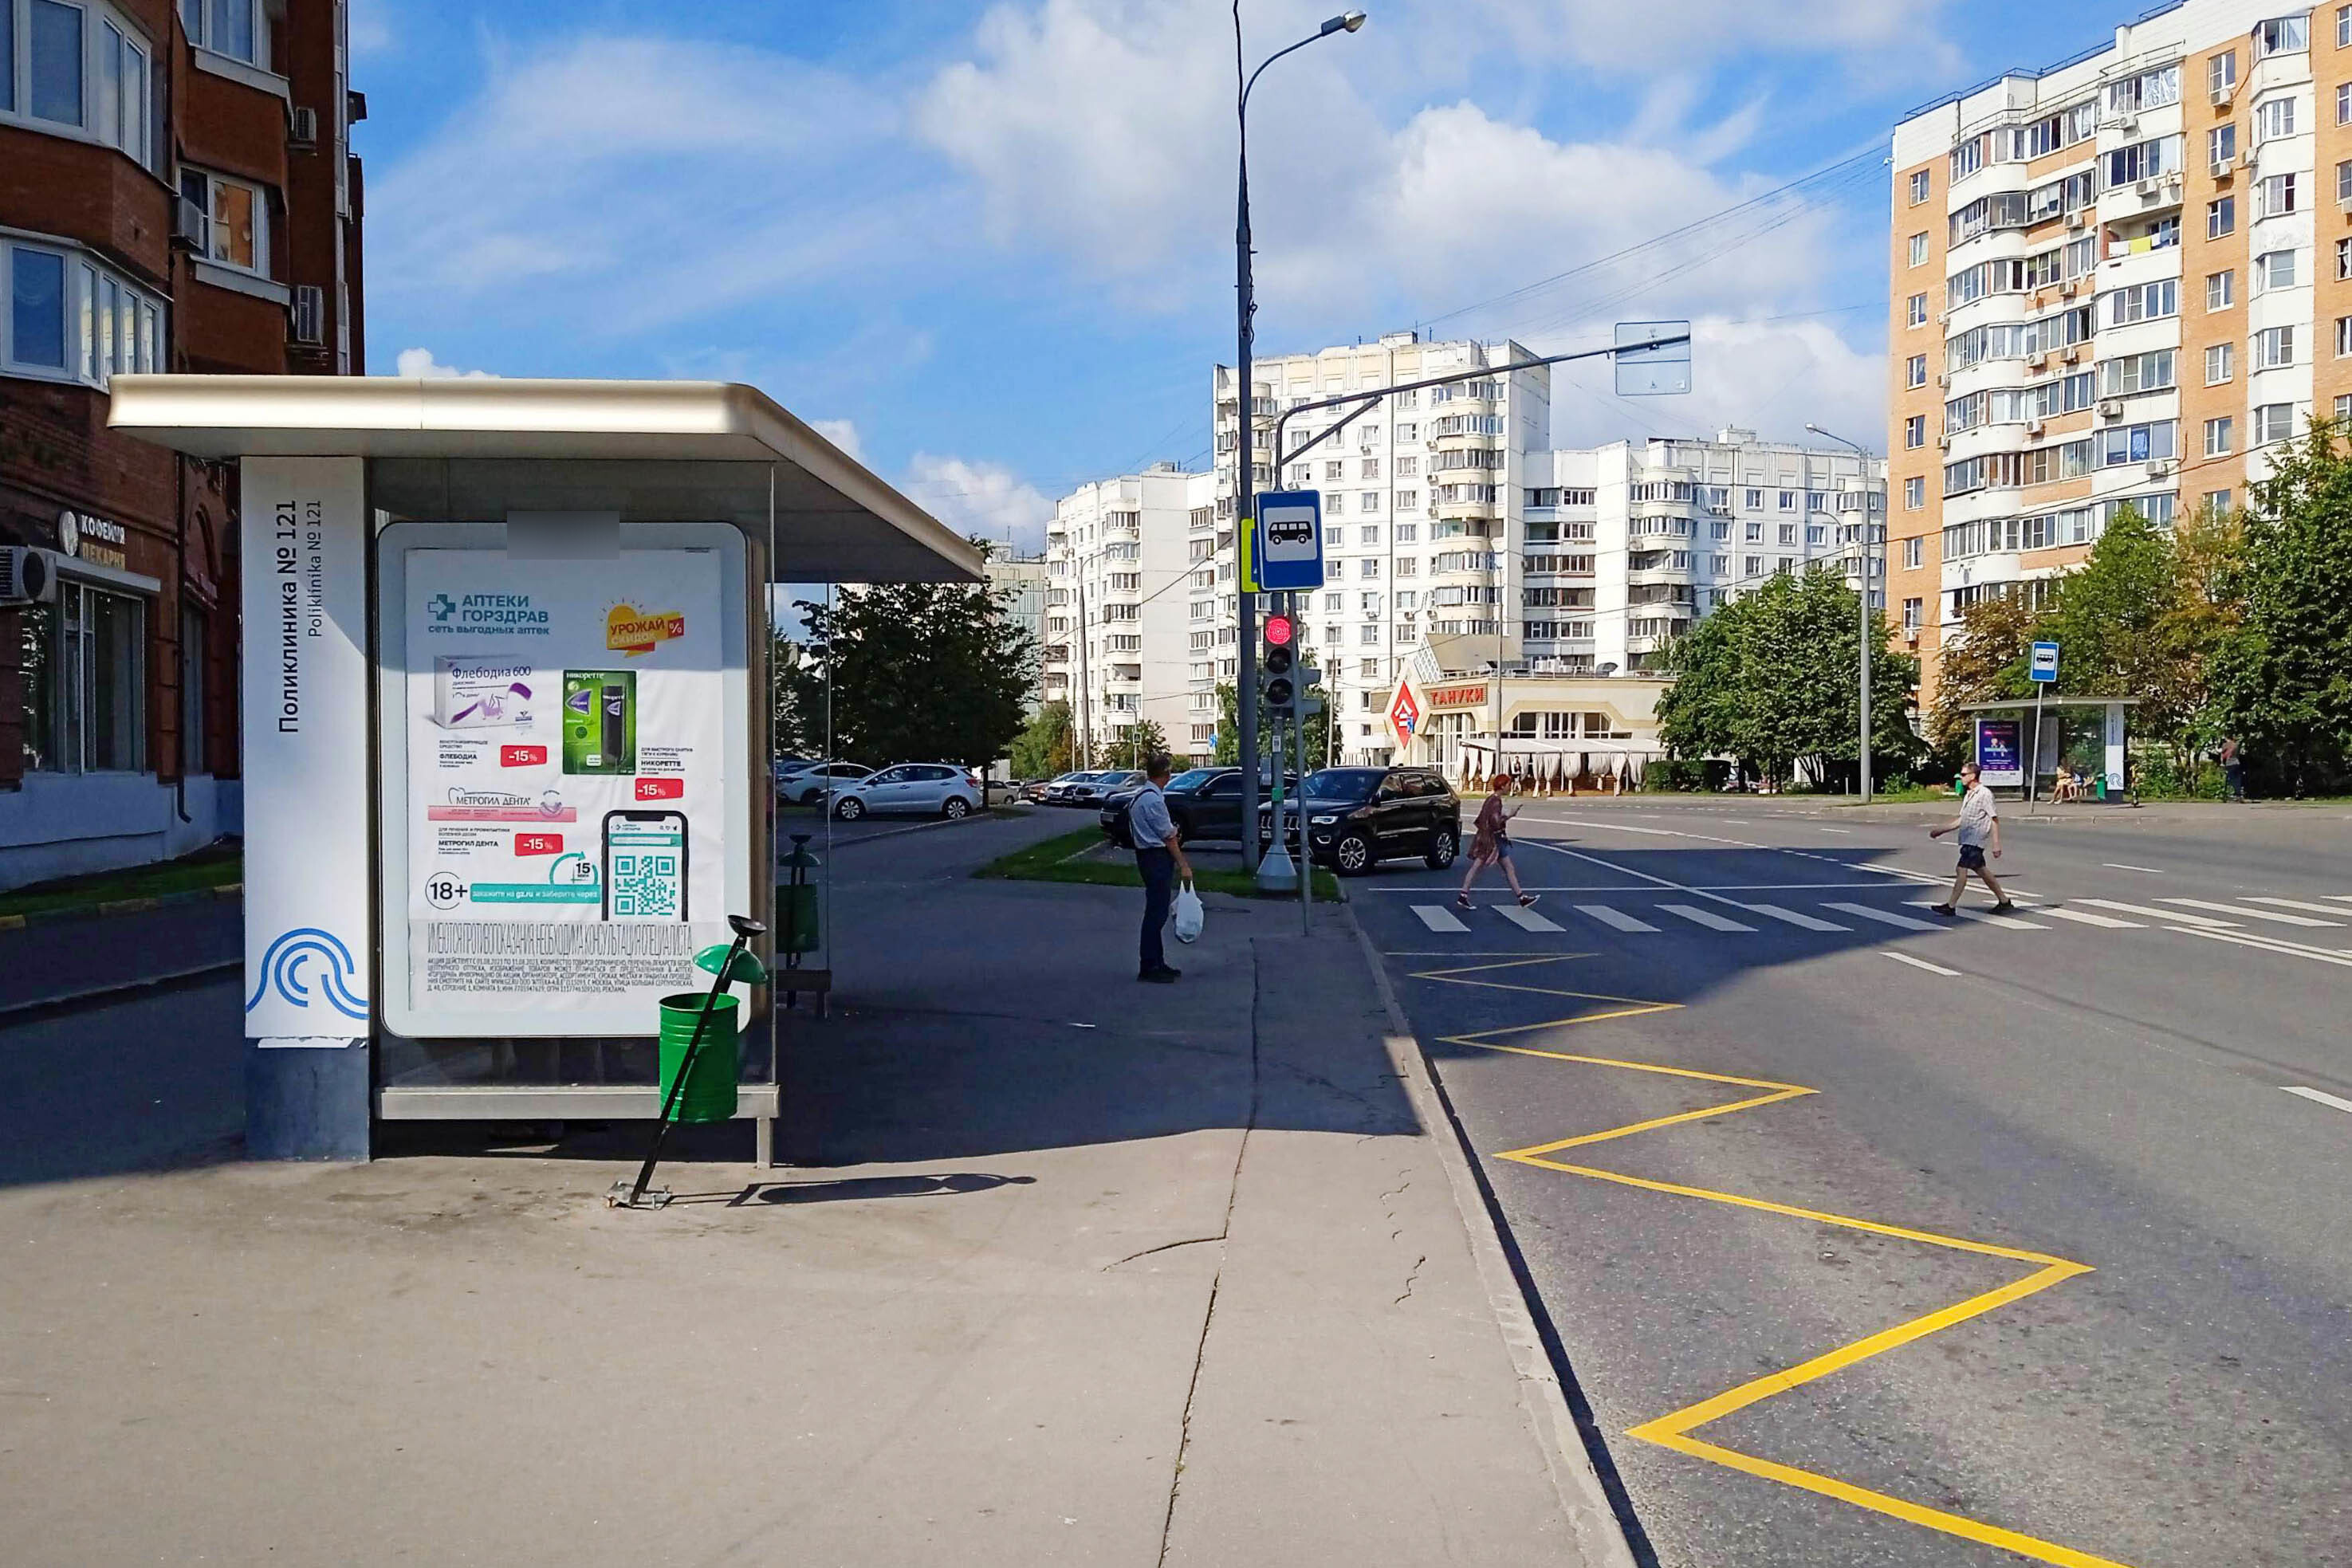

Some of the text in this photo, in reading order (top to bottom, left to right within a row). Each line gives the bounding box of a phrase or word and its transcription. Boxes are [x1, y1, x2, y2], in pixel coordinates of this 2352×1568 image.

[81, 514, 125, 544] КОФЕЙНЯ
[306, 501, 322, 637] Poliklinika № 121
[462, 595, 529, 607] АПТЕКИ
[276, 500, 299, 733] Поликлиника № 121
[462, 610, 549, 624] ГОРЗДРАВ
[456, 626, 514, 635] выгодных
[517, 627, 549, 635] аптек
[610, 617, 665, 635] УРОЖАЙ
[452, 666, 531, 679] Флебодиа 600
[1430, 687, 1484, 705] ТАНУКИ
[456, 796, 500, 805] МЕТРОГИЛ
[576, 863, 591, 874] 15
[430, 882, 468, 900] 18+
